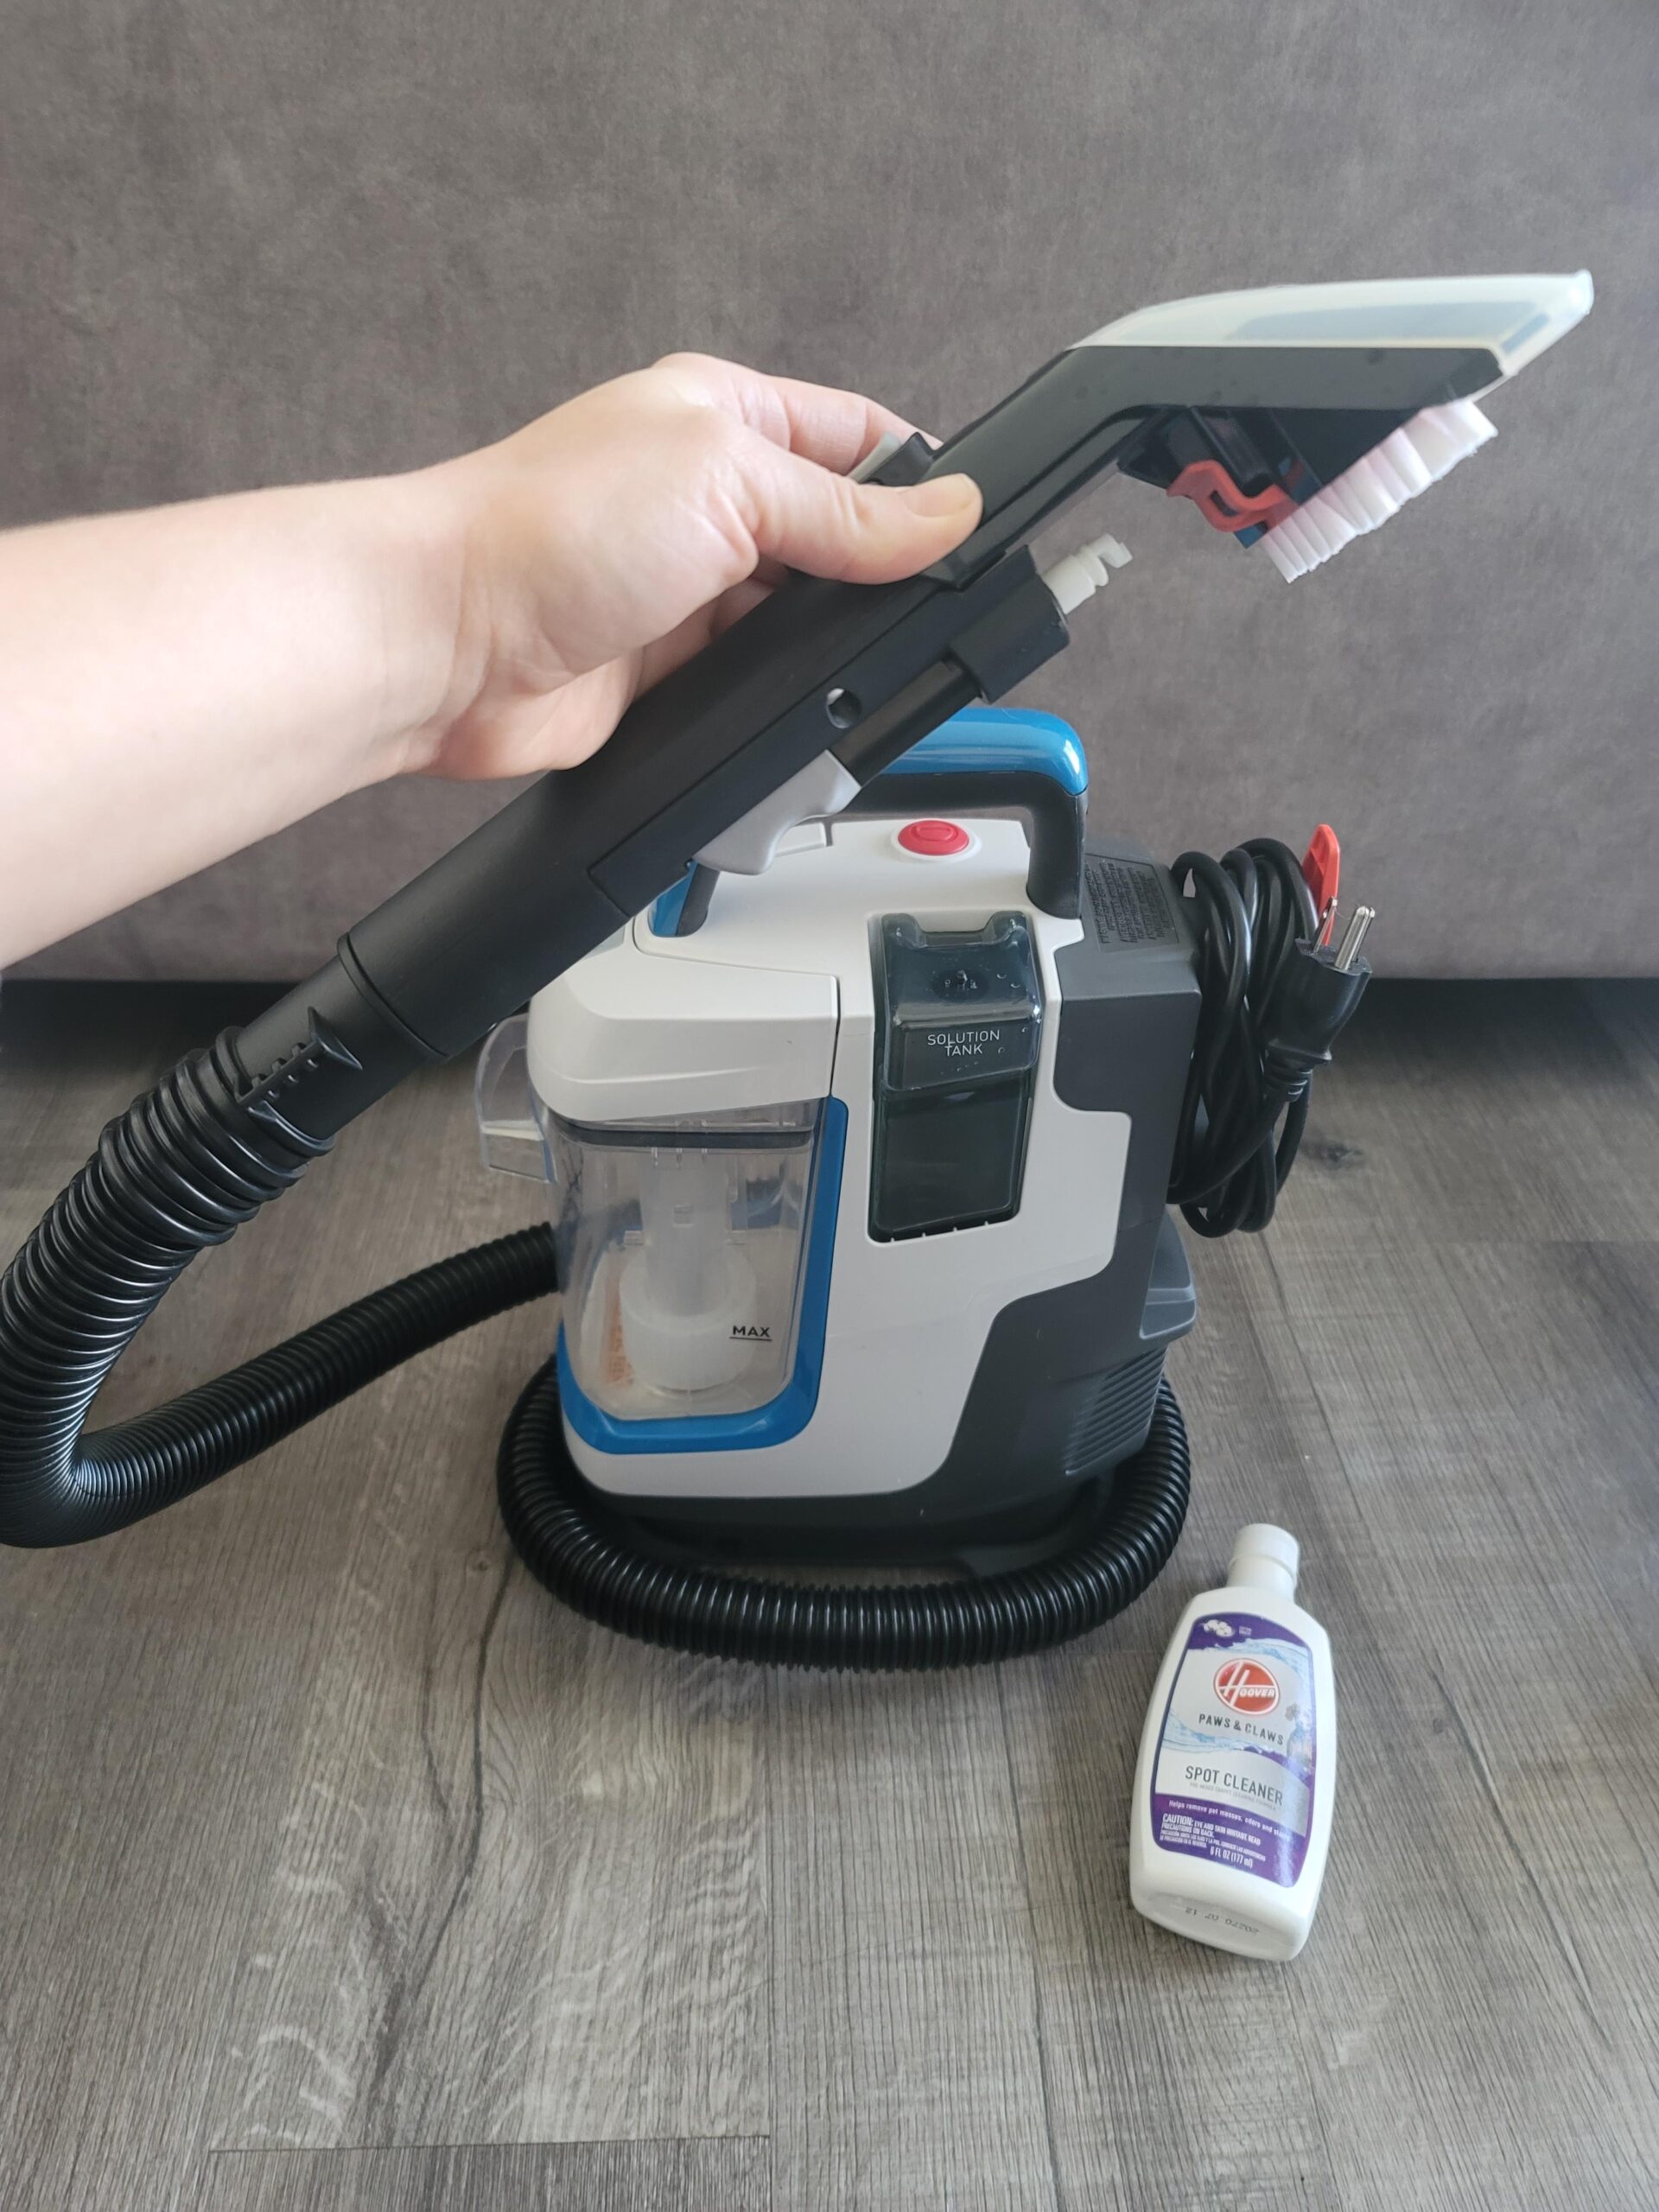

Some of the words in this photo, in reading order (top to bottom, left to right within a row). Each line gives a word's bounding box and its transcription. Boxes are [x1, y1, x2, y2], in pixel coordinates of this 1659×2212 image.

[927, 1030, 1000, 1046] SOLUTION
[944, 1044, 982, 1056] TANK
[733, 1325, 771, 1338] MAX
[1217, 1660, 1275, 1707] HOOVER
[1198, 1713, 1230, 1728] PAWS
[1233, 1720, 1242, 1732] &
[1245, 1723, 1283, 1745] CLAWS
[1185, 1765, 1220, 1784] SPOT
[1224, 1772, 1283, 1806] CLEANER
[1162, 1813, 1193, 1827] CAUTION:
[1204, 1821, 1214, 1831] AND
[1248, 1834, 1262, 1847] READ
[1169, 1800, 1185, 1810] Helps
[1186, 1803, 1207, 1812] remove
[1244, 1817, 1261, 1827] odors
[1262, 1823, 1273, 1833] and
[1210, 1846, 1214, 1856] 6
[1214, 1847, 1221, 1858] FL
[1222, 1849, 1230, 1860] OZ
[1230, 1852, 1243, 1865] (177
[1243, 1858, 1253, 1869] ml)
